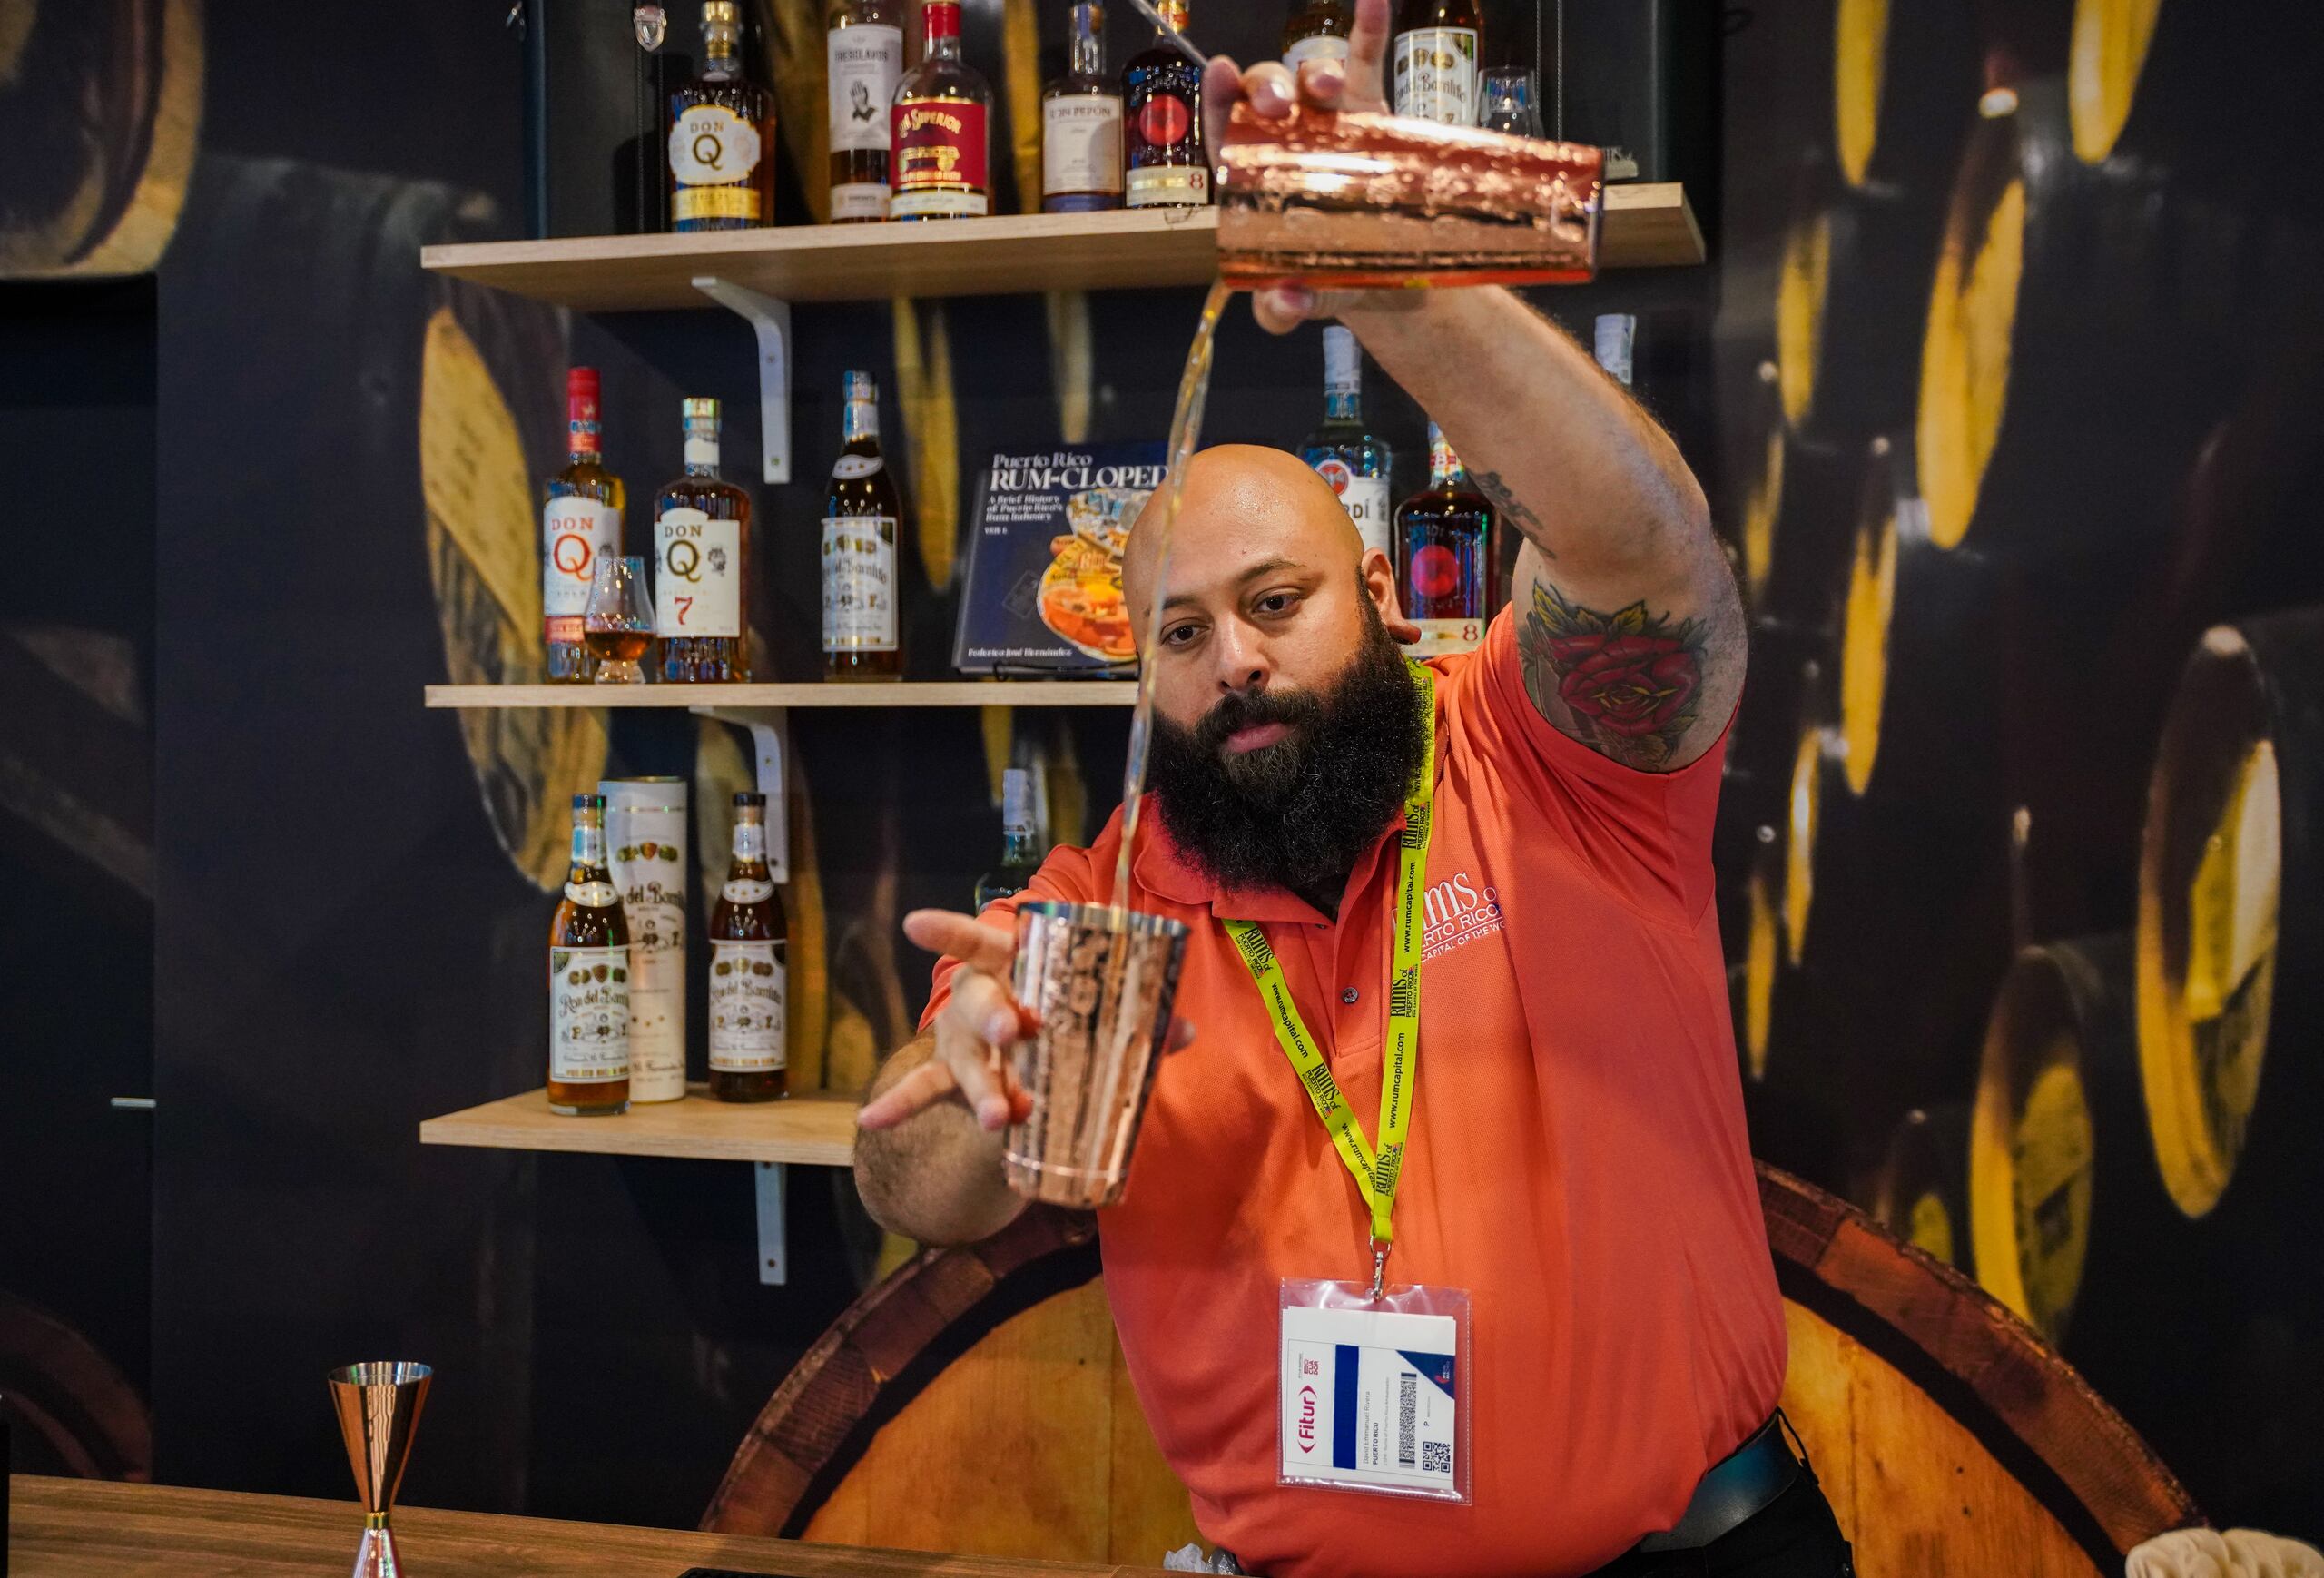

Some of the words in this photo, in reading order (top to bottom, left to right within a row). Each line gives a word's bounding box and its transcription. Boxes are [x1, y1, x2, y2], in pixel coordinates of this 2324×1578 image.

[691, 120, 724, 133] DON
[694, 133, 723, 171] Q
[1190, 173, 1204, 190] 8
[993, 453, 1050, 468] Puerto
[1052, 451, 1094, 468] Rico
[990, 465, 1169, 491] RUM-CLOPED
[551, 517, 594, 531] DON
[665, 525, 702, 538] DON
[553, 534, 595, 583] Q
[666, 539, 702, 583] Q
[675, 596, 693, 626] 7
[1462, 624, 1478, 641] 8
[1403, 862, 1416, 953] www.rumcapital.com
[1459, 903, 1499, 930] RICO
[1243, 925, 1275, 964] Rums
[1457, 933, 1471, 945] OF
[1471, 924, 1490, 940] THE
[584, 987, 598, 1005] del
[1390, 978, 1406, 1016] Rums
[1399, 969, 1406, 977] of
[1272, 982, 1308, 1058] www.rumcapital.com
[1311, 1061, 1340, 1101] Rums
[1329, 1100, 1341, 1109] of
[1389, 1032, 1405, 1129] www.rumcapital.com
[1375, 1153, 1390, 1193] Rums
[1384, 1142, 1392, 1153] of
[1298, 1396, 1315, 1439] Fitur
